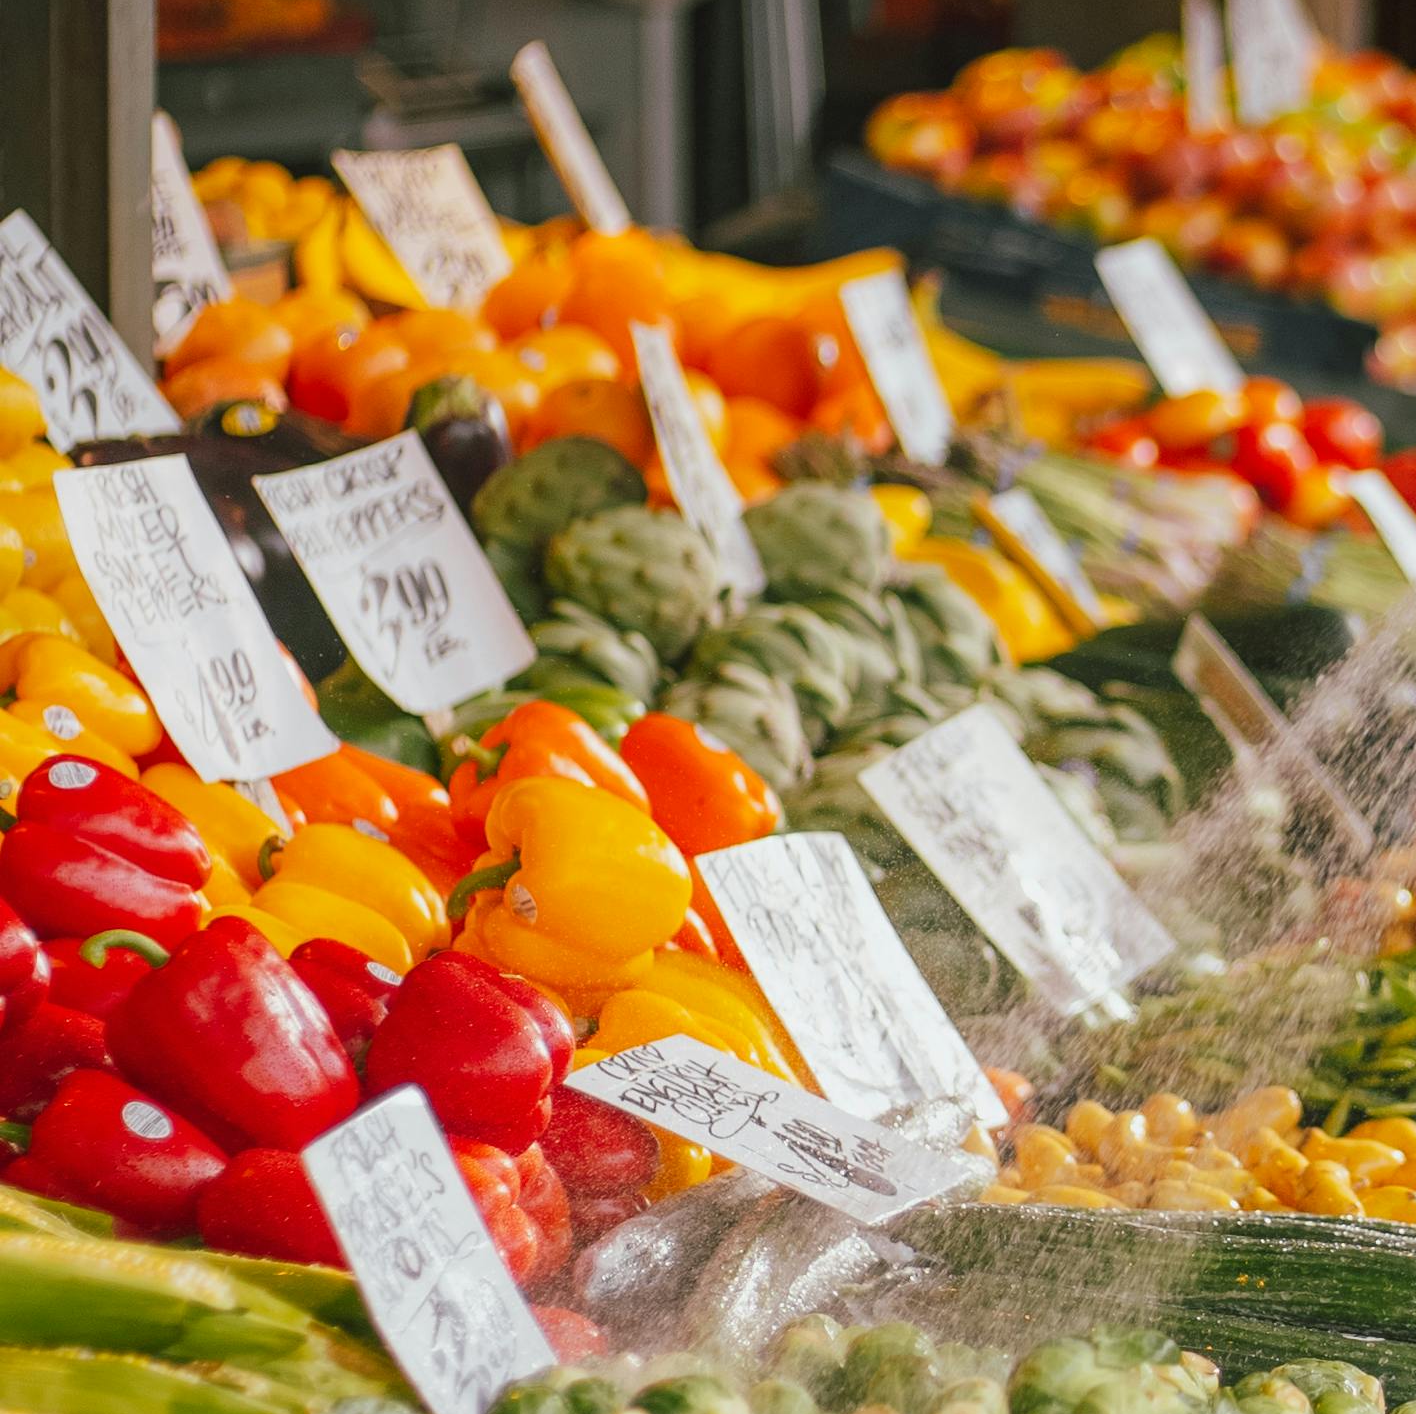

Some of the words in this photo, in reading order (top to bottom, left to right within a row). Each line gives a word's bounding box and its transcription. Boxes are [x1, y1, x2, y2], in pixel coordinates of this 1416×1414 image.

[82, 466, 158, 510] FRESH
[95, 503, 179, 553] MIXED
[94, 534, 196, 590] SWEET
[619, 1059, 730, 1113] ENGLISH
